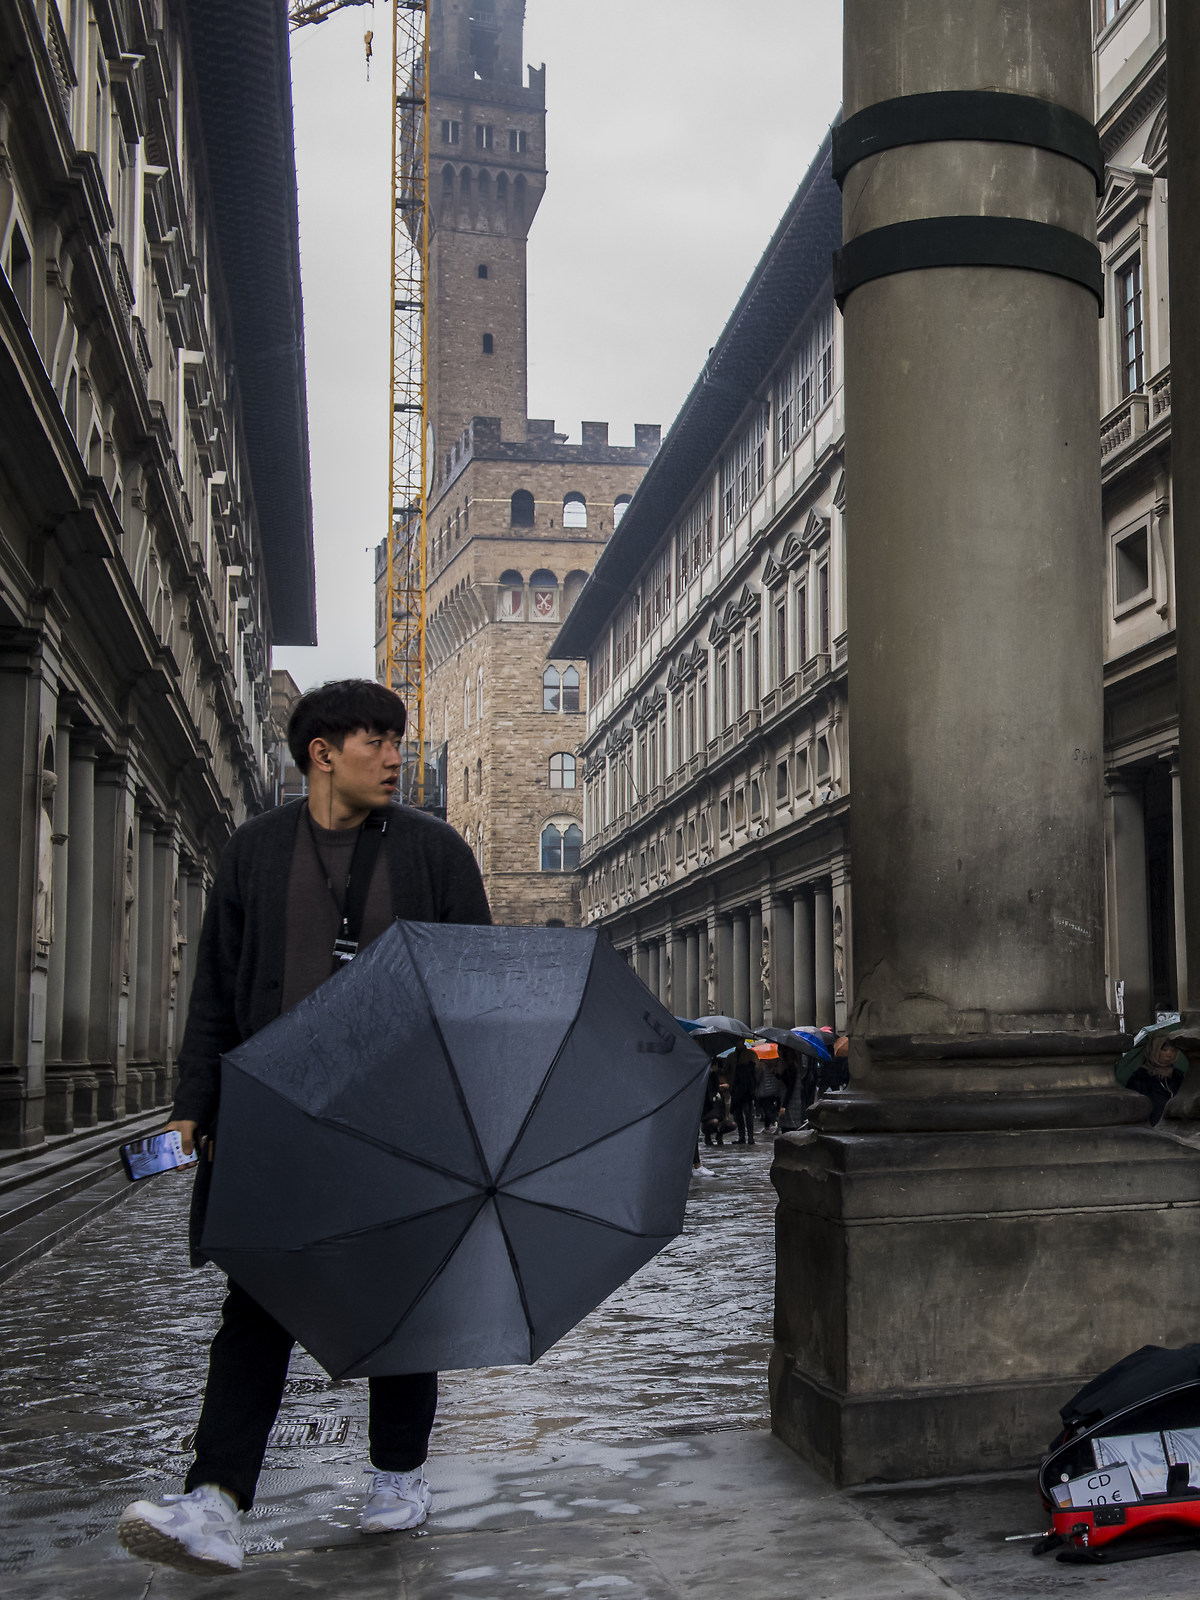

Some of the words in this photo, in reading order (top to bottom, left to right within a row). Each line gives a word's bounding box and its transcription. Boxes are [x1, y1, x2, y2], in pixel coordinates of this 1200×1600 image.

[1087, 1474, 1111, 1490] CD
[1087, 1495, 1107, 1506] 10
[1111, 1490, 1123, 1502] €
